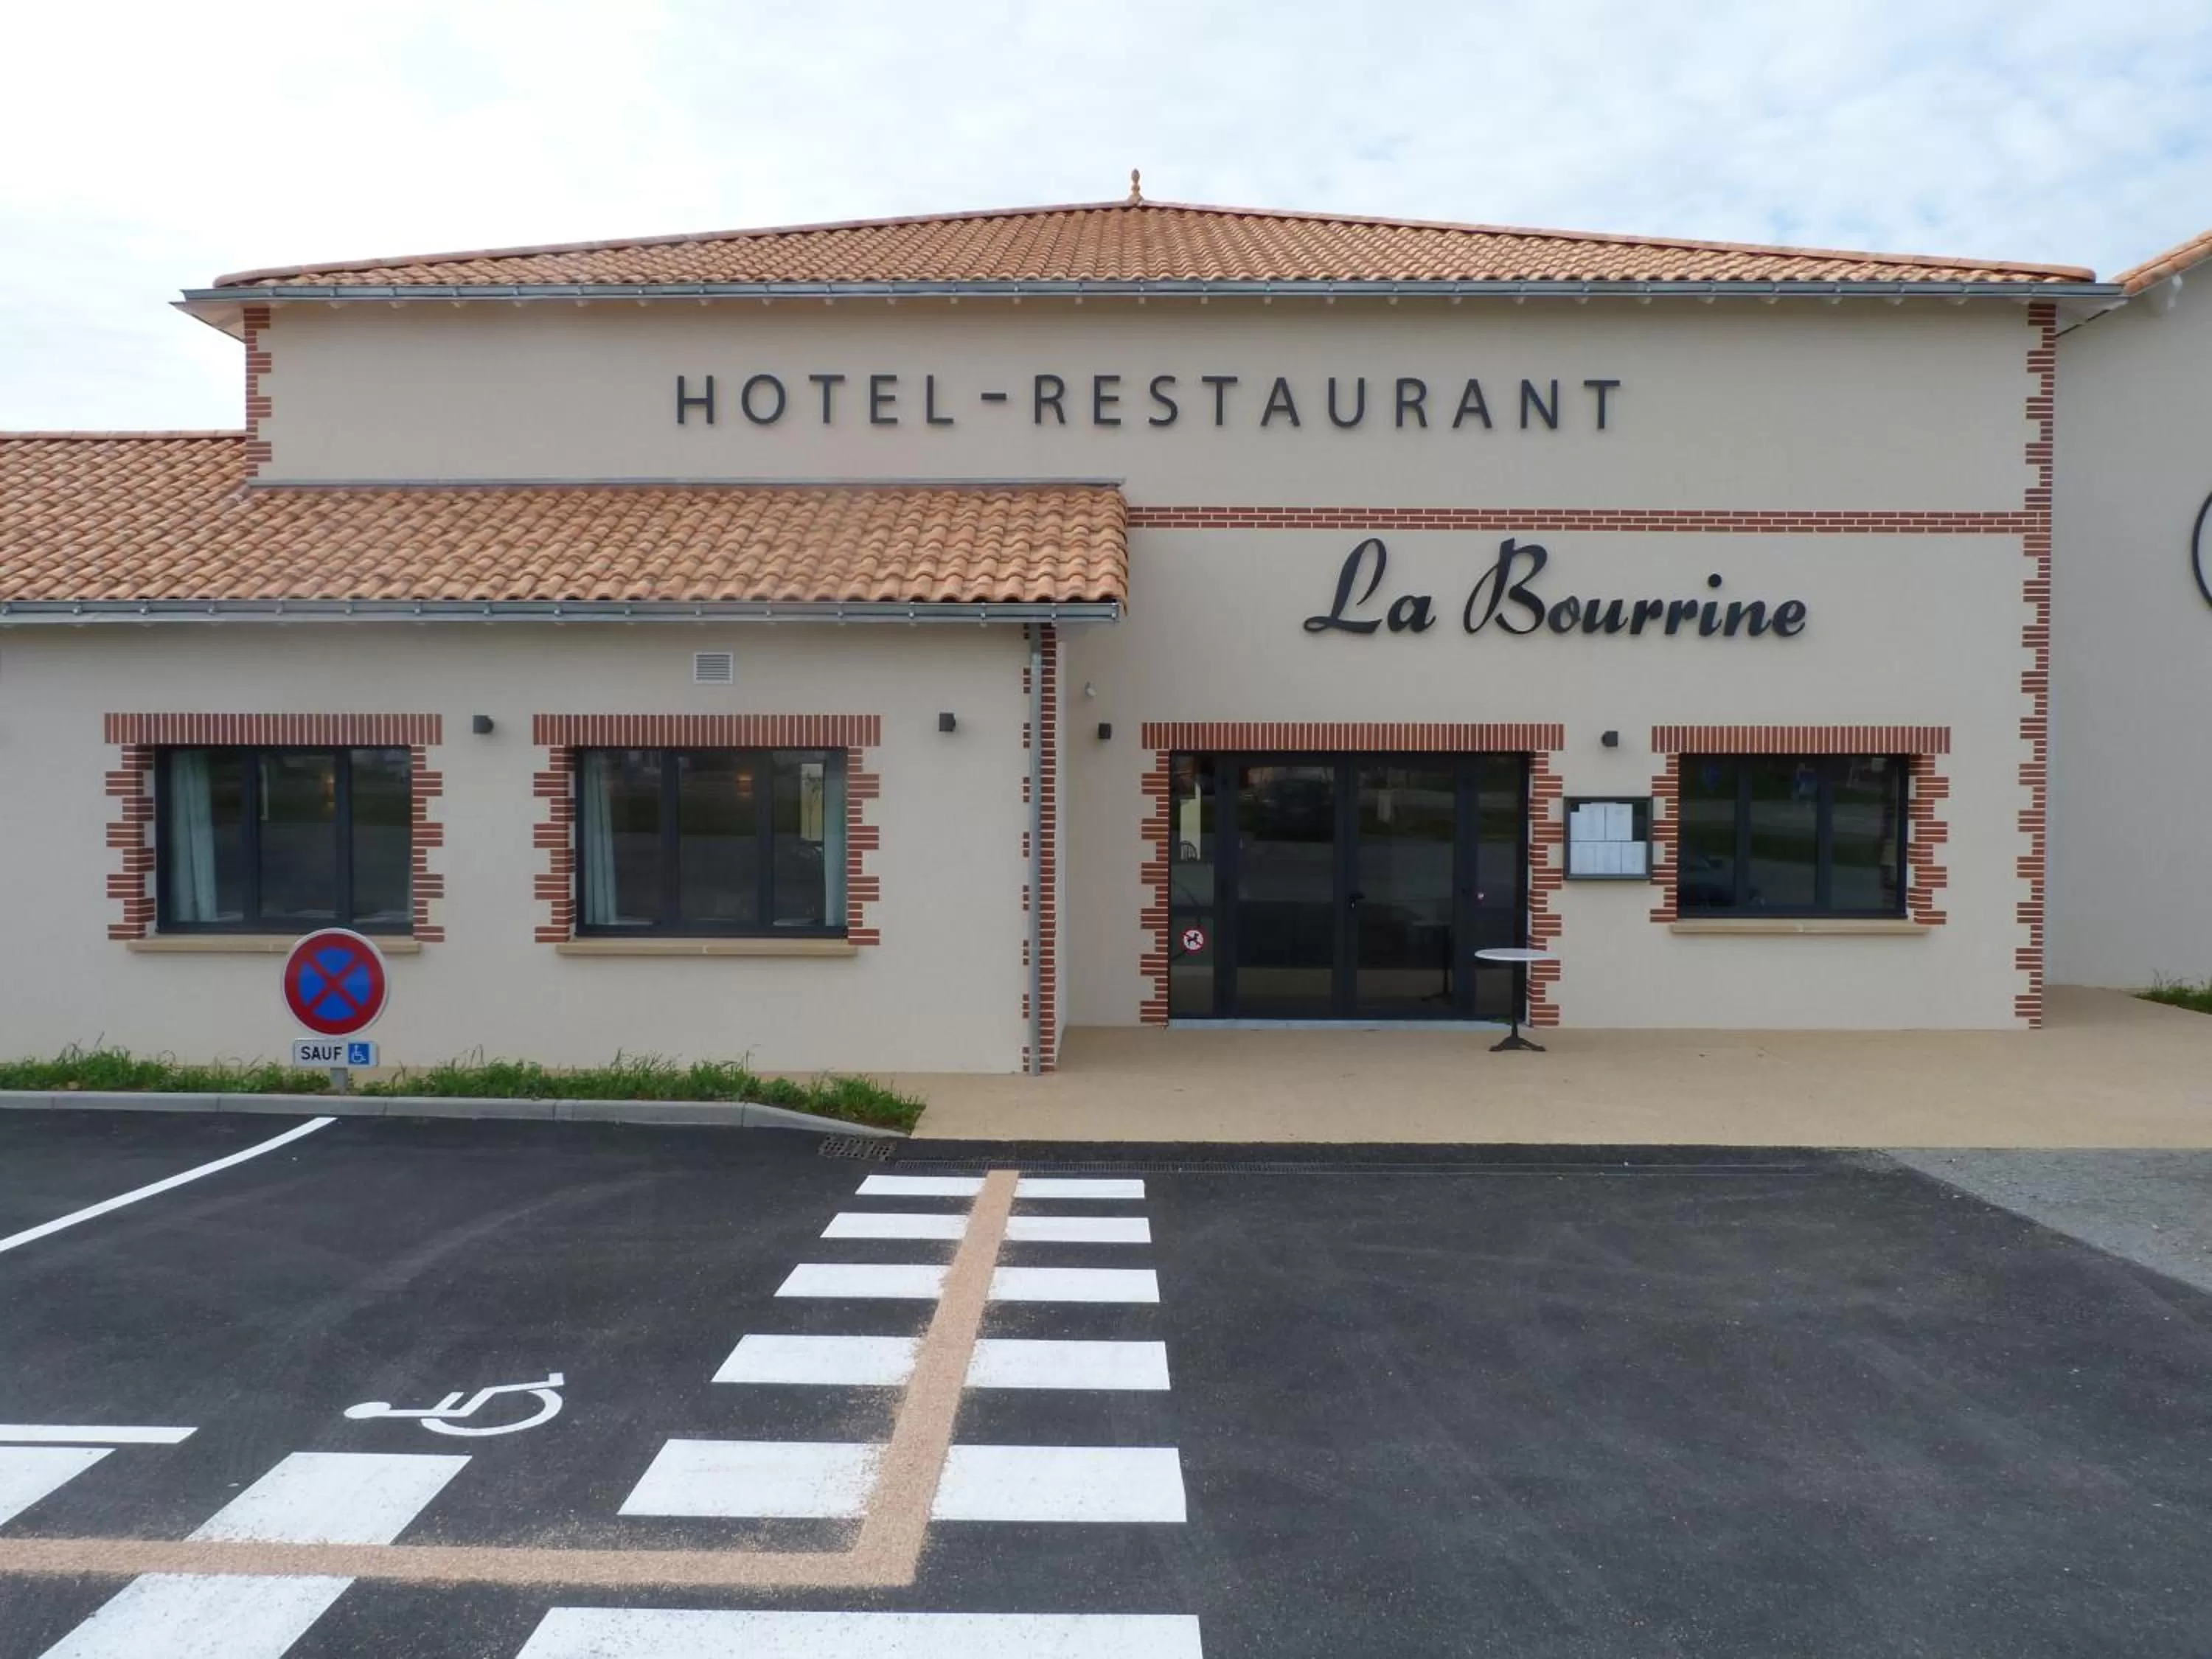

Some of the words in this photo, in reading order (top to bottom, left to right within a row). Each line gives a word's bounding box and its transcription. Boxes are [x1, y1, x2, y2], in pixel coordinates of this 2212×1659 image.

[1303, 538, 1437, 637] La
[1462, 537, 1808, 639] Bourrine
[300, 1046, 343, 1061] SAUF
